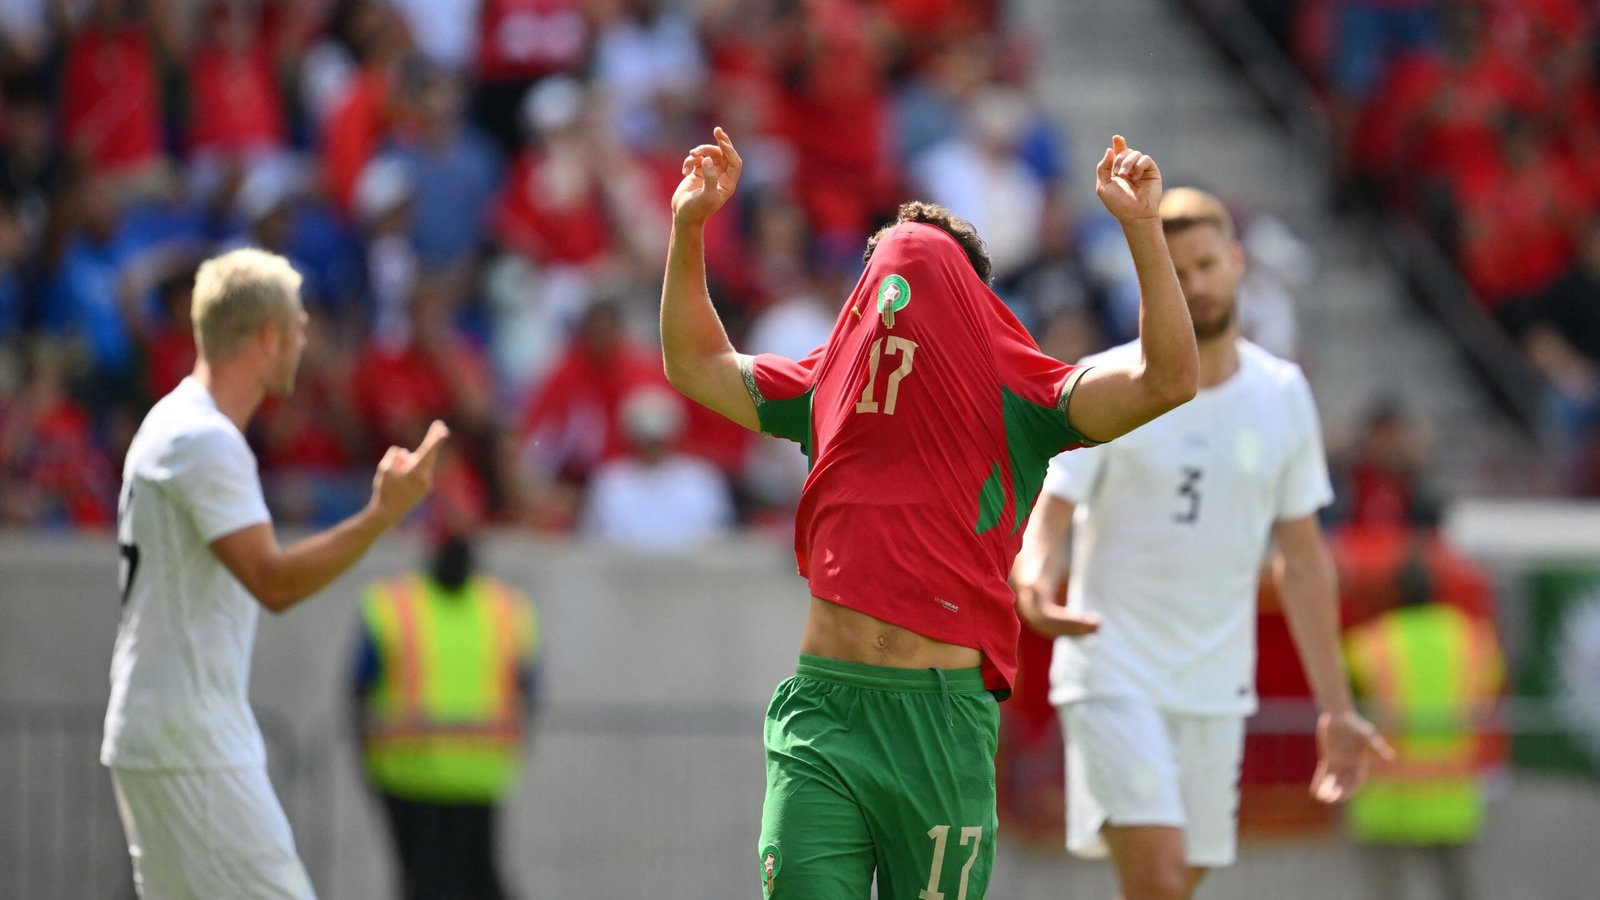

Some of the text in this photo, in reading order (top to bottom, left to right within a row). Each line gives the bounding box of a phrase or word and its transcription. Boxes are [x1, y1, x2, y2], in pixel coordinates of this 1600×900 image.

[856, 335, 919, 415] 17
[1174, 465, 1202, 524] 3
[919, 824, 982, 900] 17
